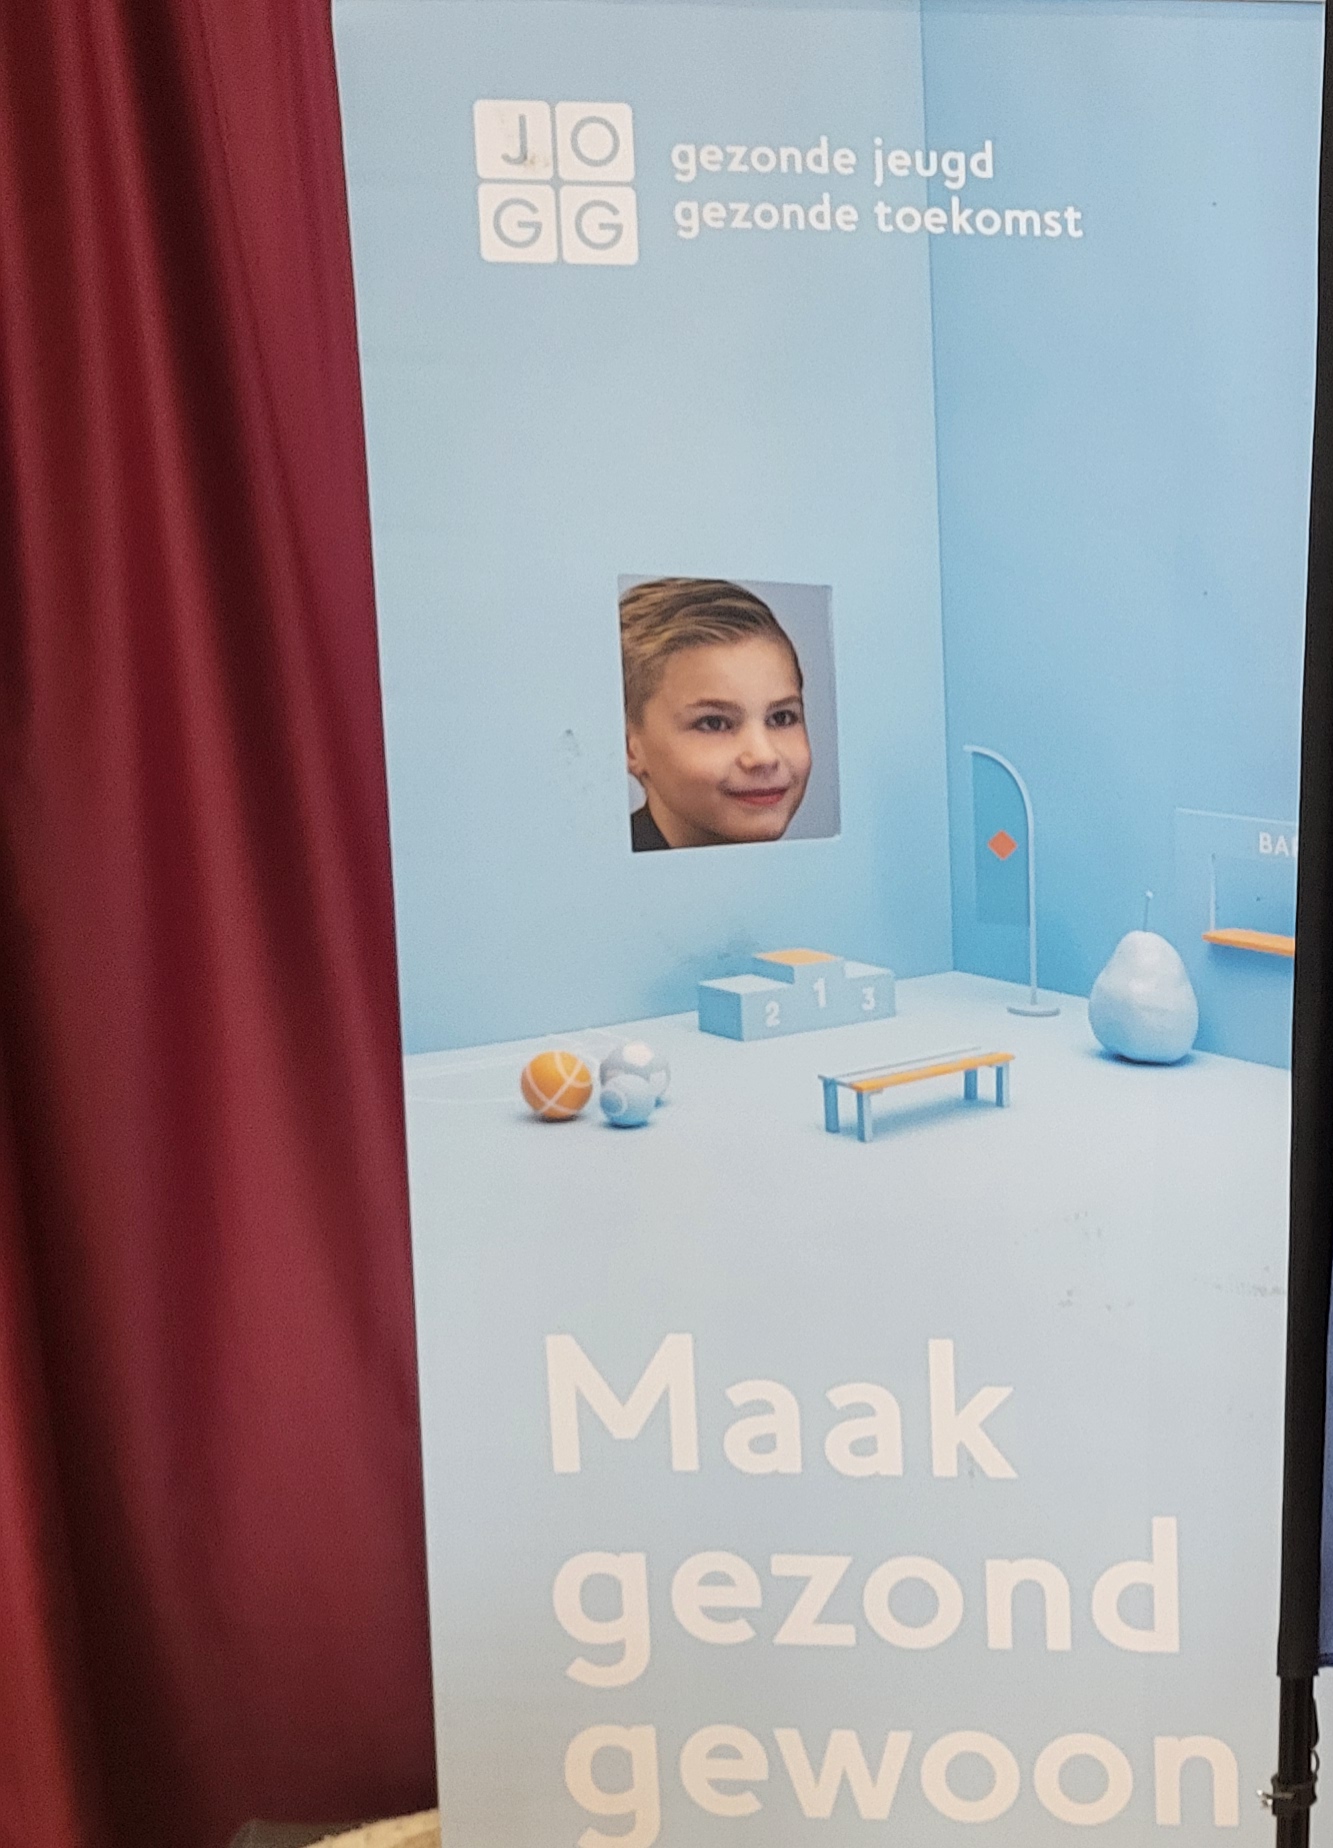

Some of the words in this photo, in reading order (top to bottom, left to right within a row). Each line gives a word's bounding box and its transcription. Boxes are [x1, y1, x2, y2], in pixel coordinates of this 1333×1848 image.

[671, 135, 856, 183] gezonde
[873, 137, 994, 189] jeugd
[674, 192, 859, 239] gezonde
[875, 196, 1084, 239] toekomst
[765, 1001, 780, 1027] 2
[813, 978, 826, 1008] 1
[862, 987, 875, 1011] 3
[545, 1333, 1018, 1478] Maak
[552, 1516, 1180, 1688] gezond
[563, 1723, 1240, 1848] gewoon
